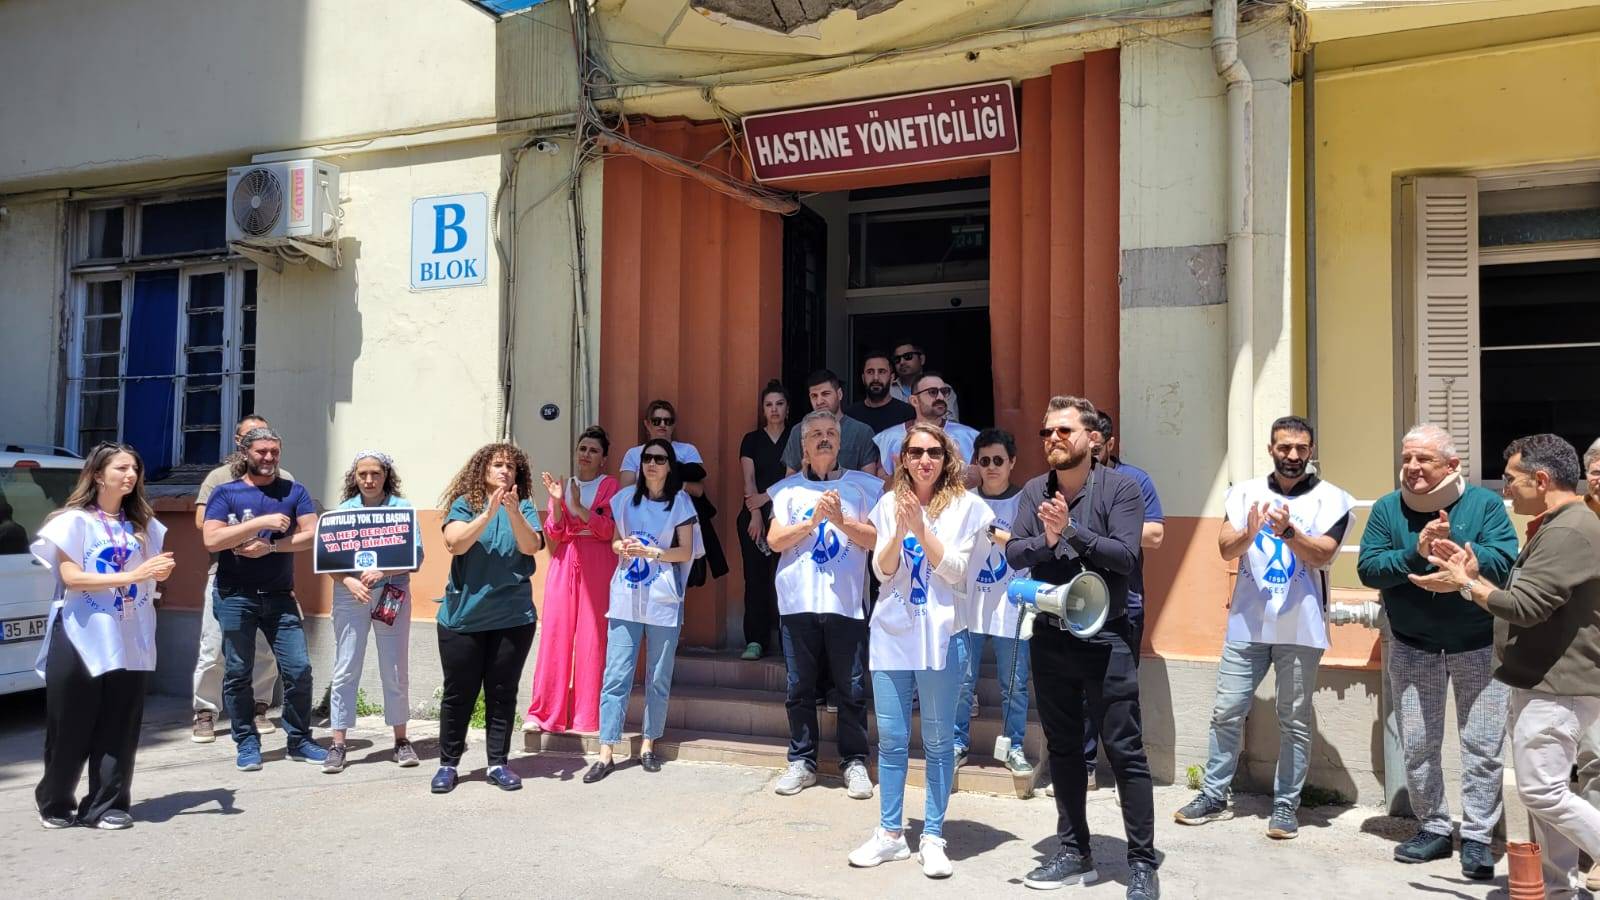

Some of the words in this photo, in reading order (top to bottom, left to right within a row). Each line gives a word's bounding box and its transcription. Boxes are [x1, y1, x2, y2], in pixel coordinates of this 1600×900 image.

[755, 125, 853, 167] HASTANE
[855, 93, 1006, 155] YÖNETİCİLİĞİ
[431, 203, 468, 254] B
[420, 258, 478, 281] BLOK
[322, 514, 356, 527] KURTULUŞ
[357, 513, 372, 524] YOK
[372, 513, 385, 523] TEK
[385, 512, 411, 525] BAŞINA
[320, 533, 336, 542] YA
[336, 529, 359, 541] HEP
[360, 524, 410, 537] BERABER
[325, 543, 340, 552] YA
[341, 539, 360, 551] HİÇ
[5, 622, 21, 638] 35
